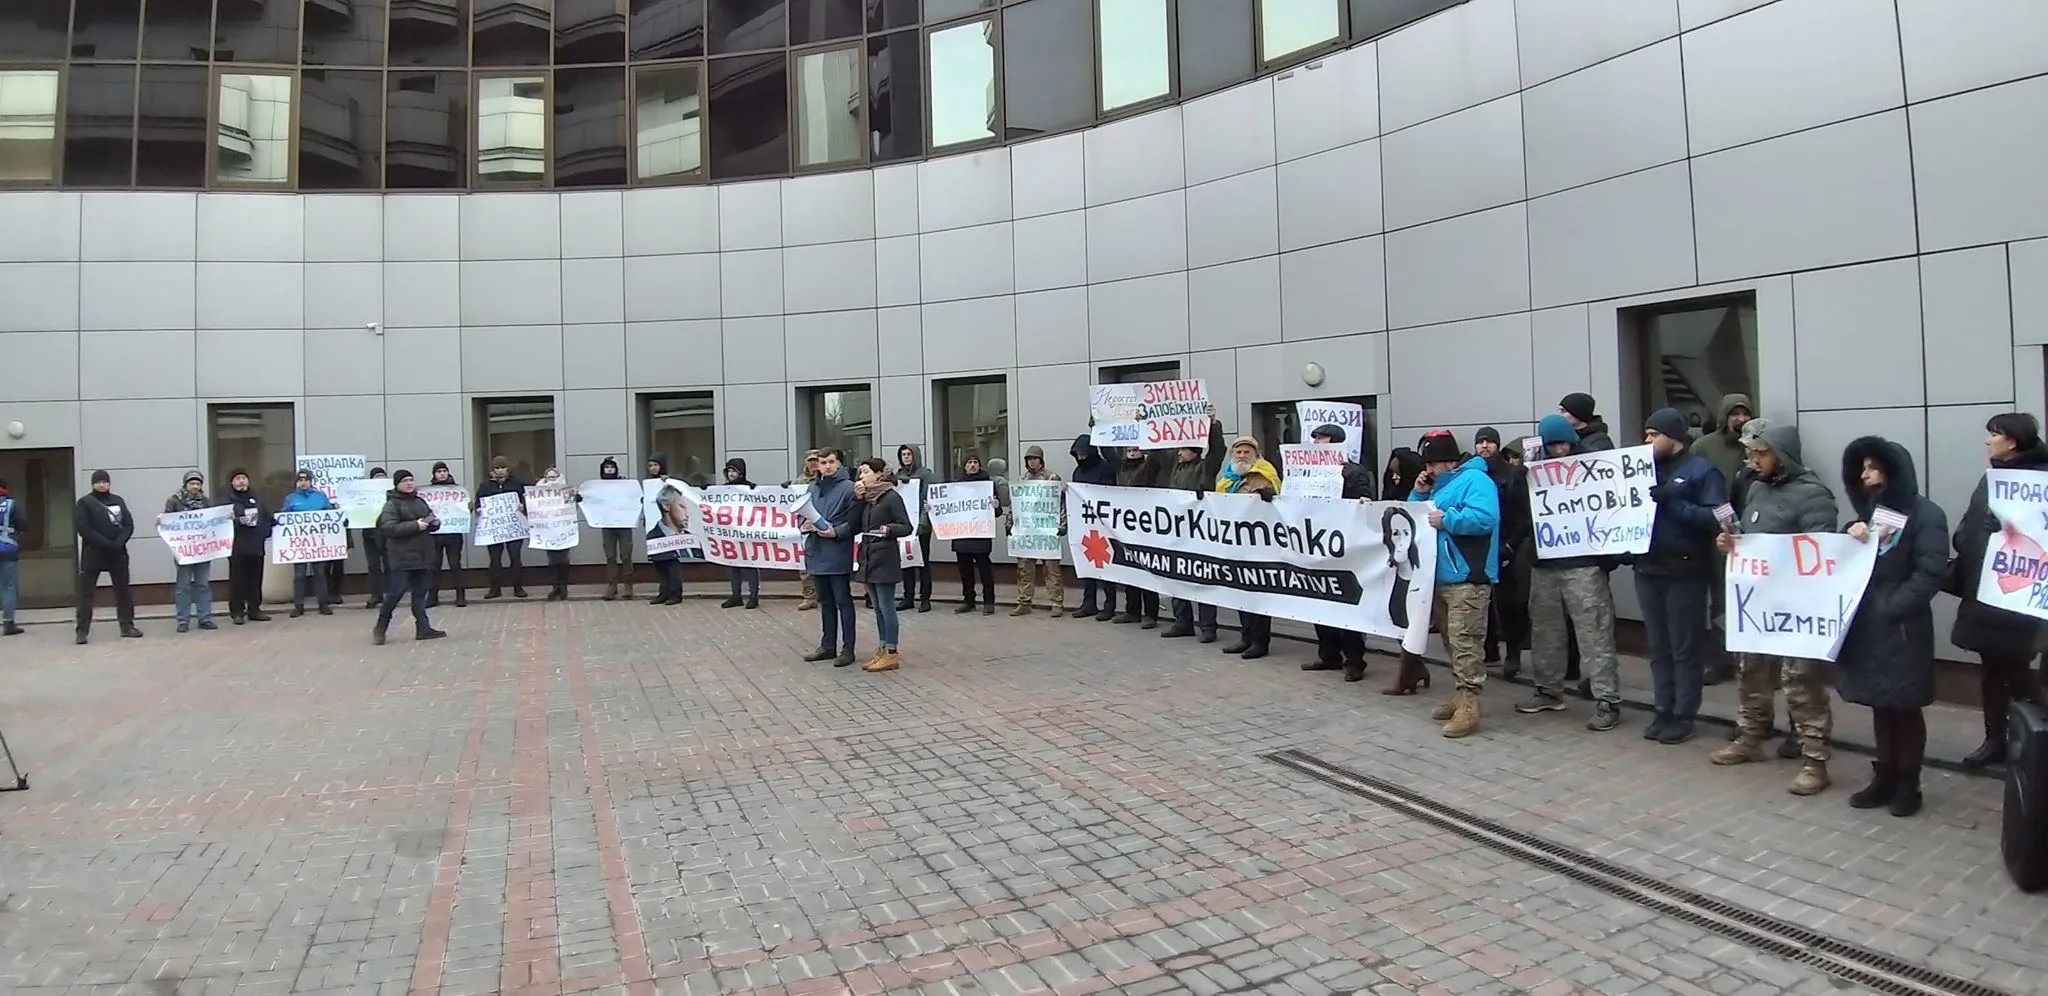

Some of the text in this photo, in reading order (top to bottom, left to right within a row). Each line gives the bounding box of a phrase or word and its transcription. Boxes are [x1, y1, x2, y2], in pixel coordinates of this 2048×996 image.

[1144, 380, 1201, 404] ЗМІНИ
[1138, 398, 1208, 421] ЗАПОБІЖНИЙ
[1304, 408, 1362, 428] ДОКАЗИ
[1147, 416, 1209, 444] ЗАХІД
[1530, 460, 1579, 489] ГПУ
[701, 493, 776, 504] НЕДОСТАТНЬО
[930, 485, 949, 500] НЕ
[277, 511, 345, 526] СВОБОДУ
[282, 523, 340, 537] ЛІКАРЮ
[703, 525, 716, 535] НЕ
[717, 527, 778, 541] ЗВІЛЬНЯЄШ
[1081, 500, 1345, 558] #FreeDrKuzmenko
[289, 534, 326, 548] ЮЛІЇ
[279, 545, 347, 562] КУЗЬМЕНКО
[1792, 534, 1836, 576] Dr
[1124, 547, 1344, 597] HUMAN RIGHTS INITIATIVE
